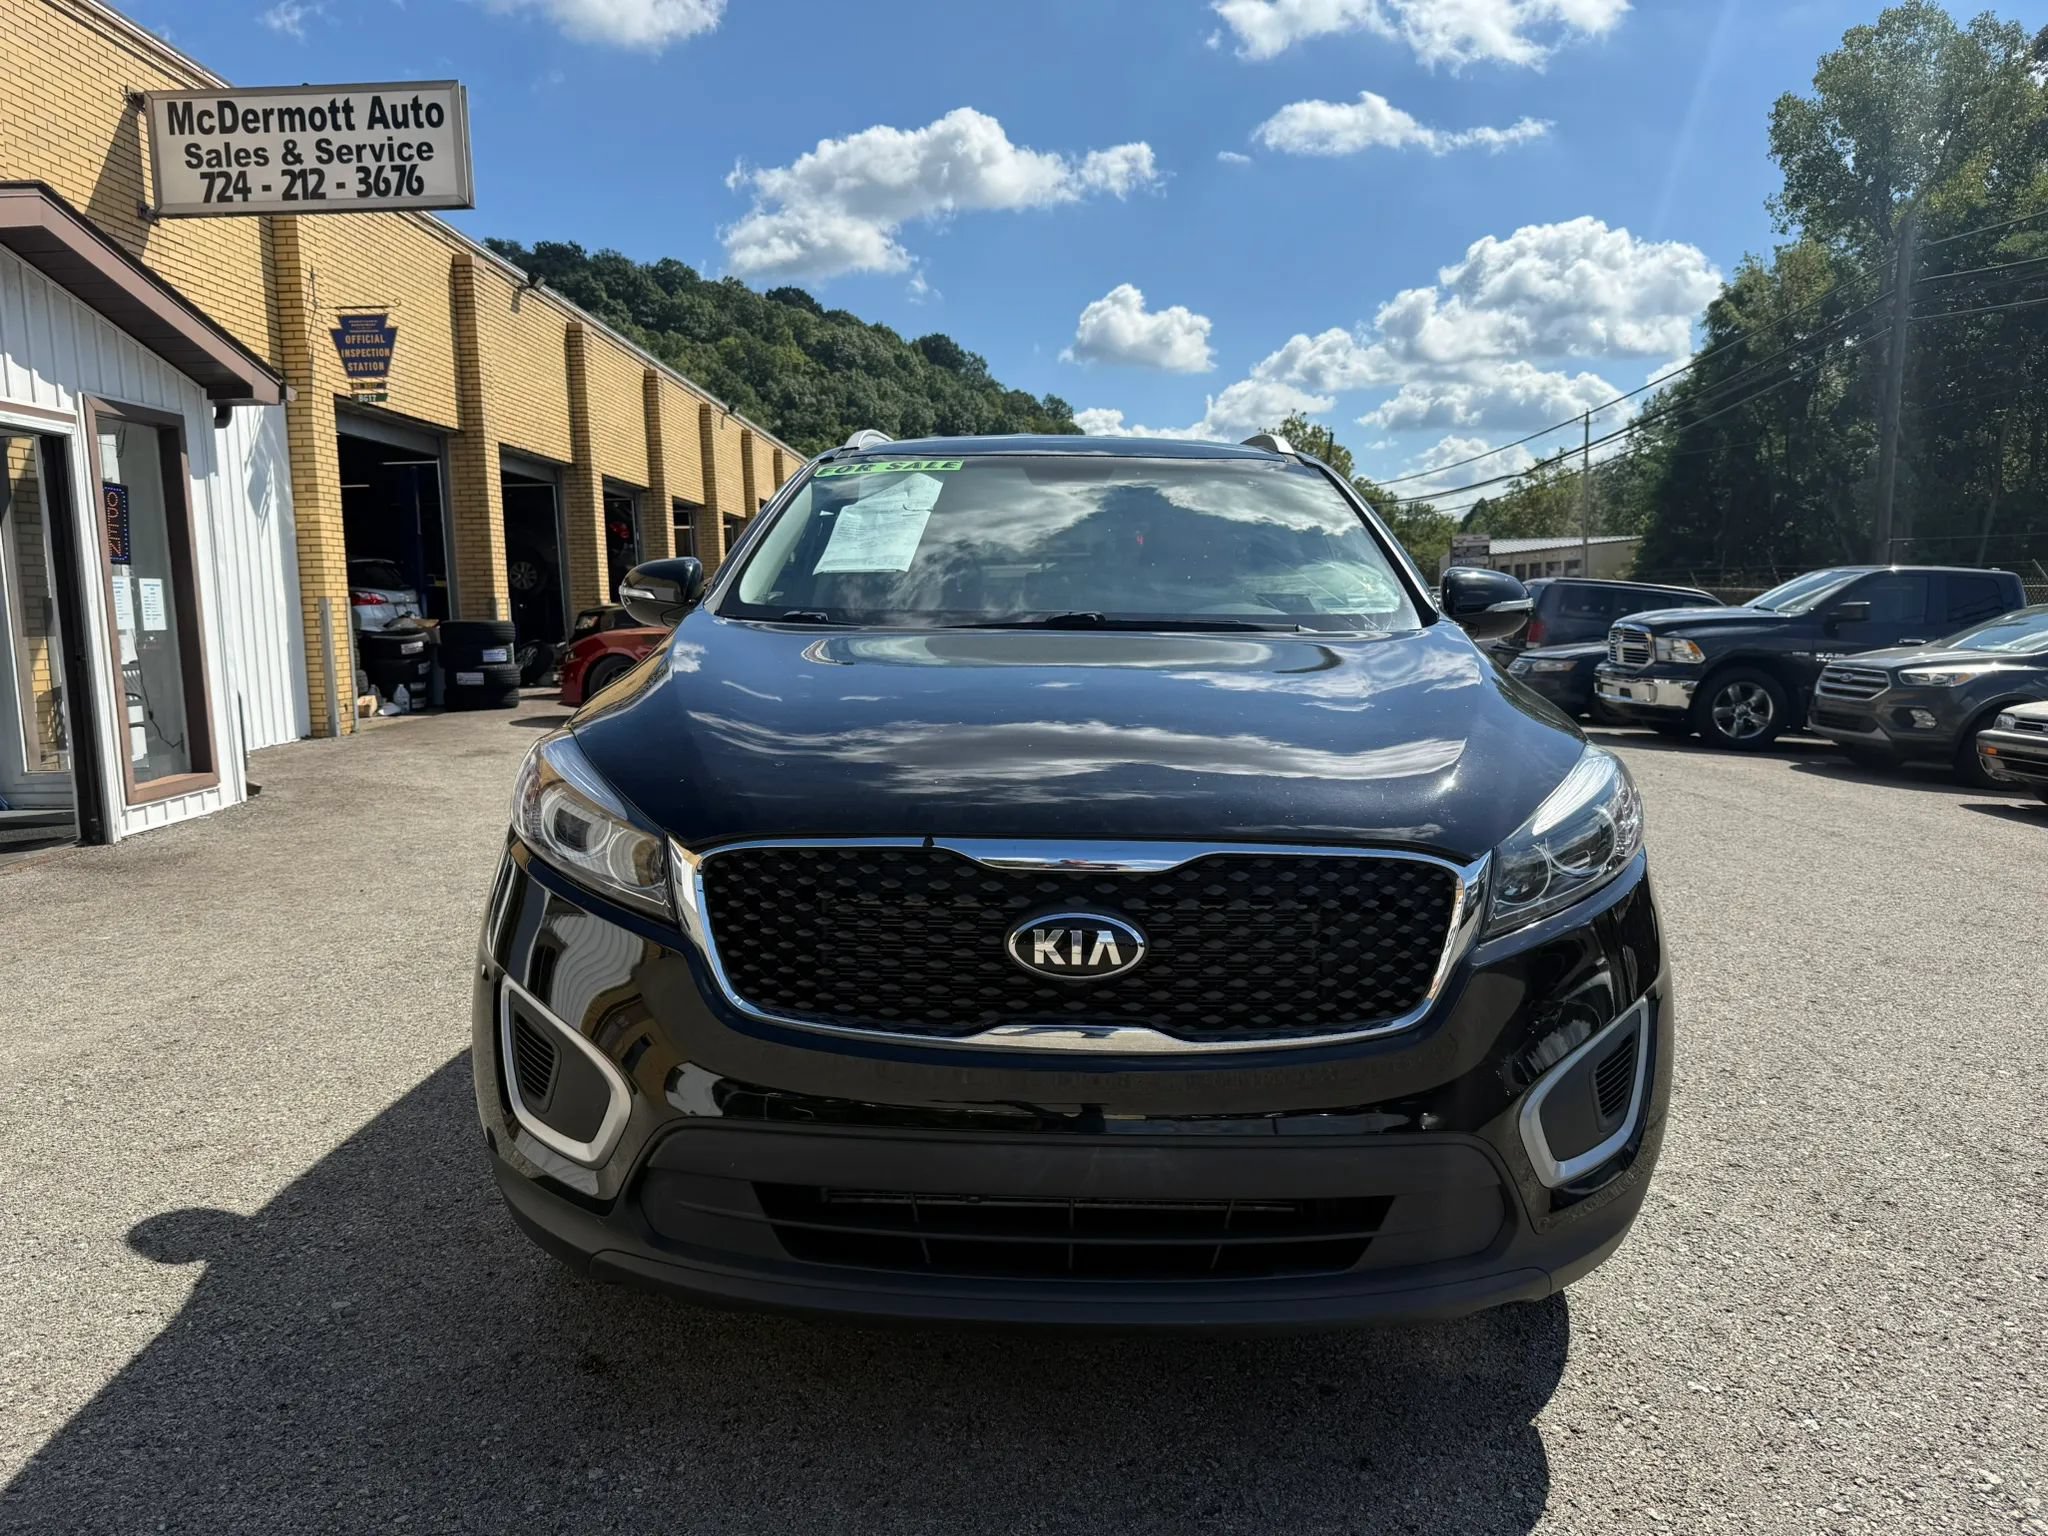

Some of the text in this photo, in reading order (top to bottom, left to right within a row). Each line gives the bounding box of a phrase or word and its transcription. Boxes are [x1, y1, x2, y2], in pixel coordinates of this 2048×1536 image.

[166, 94, 444, 135] McDermott Auto
[184, 136, 434, 170] Sales & Service
[199, 170, 252, 204] 724
[280, 167, 326, 201] 212
[356, 163, 424, 198] 3676
[341, 348, 390, 358] INSPECTION
[345, 335, 385, 344] OFFICIAL
[348, 361, 385, 371] STATION
[816, 461, 960, 476] FOR SALE
[106, 491, 122, 557] OPEN
[1032, 929, 1122, 966] KIA
